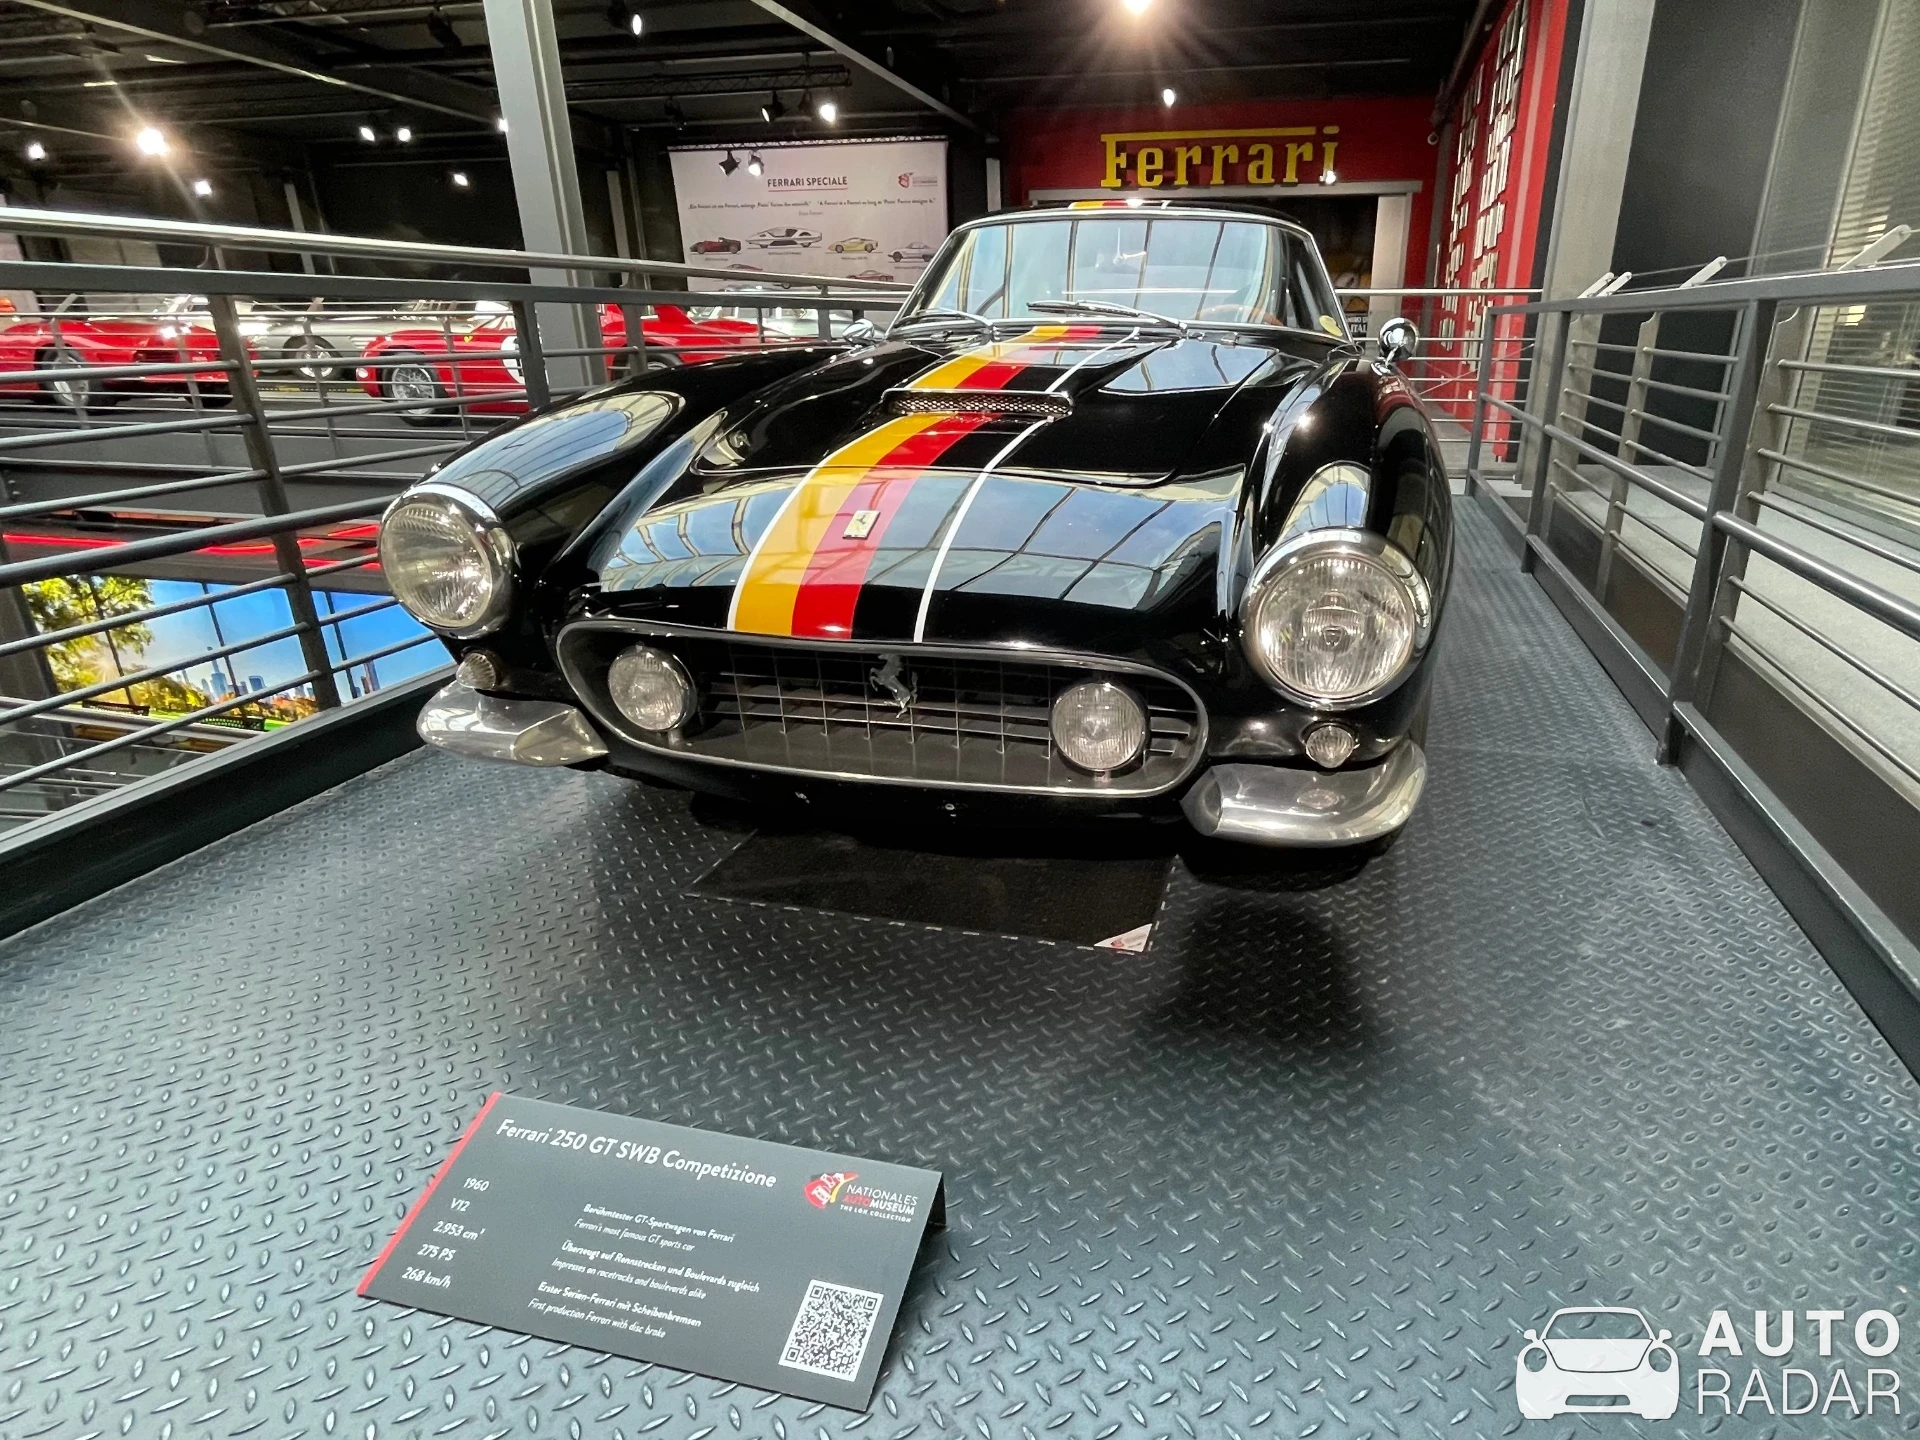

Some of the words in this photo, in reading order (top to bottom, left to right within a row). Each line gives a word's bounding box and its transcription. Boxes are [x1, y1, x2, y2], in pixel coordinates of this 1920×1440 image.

[1100, 125, 1340, 188] Ferrari
[767, 178, 805, 188] FERRARI
[806, 176, 848, 186] SPECIALE
[496, 1119, 553, 1144] Ferrari
[550, 1129, 588, 1150] 250
[589, 1136, 618, 1156] GT
[616, 1141, 661, 1165] SWB
[663, 1150, 777, 1188] Competizione
[463, 1177, 490, 1192] 1960
[846, 1184, 918, 1206] NATIONALES
[450, 1197, 471, 1212] V12
[840, 1204, 852, 1212] THE
[869, 1209, 912, 1223] COLLECTION
[432, 1220, 464, 1237] 2.953
[583, 1203, 634, 1222] Berühmtester
[634, 1213, 692, 1235] GT-Sportwagen
[692, 1228, 707, 1237] von
[707, 1228, 736, 1243] Ferrari
[602, 1226, 621, 1237] most
[618, 1228, 648, 1242] famous
[648, 1234, 662, 1244] GT
[659, 1238, 683, 1249] sports
[416, 1243, 440, 1258] 275
[438, 1247, 457, 1261] PS
[401, 1266, 426, 1282] 268
[423, 1271, 452, 1288] km/h
[551, 1257, 587, 1273] Impresses
[596, 1269, 635, 1283] racetracks
[634, 1277, 652, 1287] and
[649, 1279, 688, 1296] boulevards
[687, 1287, 707, 1300] alike
[600, 1251, 616, 1261] auf
[614, 1252, 667, 1273] Rennstrecken
[667, 1266, 685, 1276] und
[684, 1267, 727, 1286] Boulevards
[727, 1280, 760, 1293] zugleich
[537, 1281, 562, 1295] Erster
[562, 1286, 618, 1308] Serien-Ferrari
[616, 1300, 632, 1311] mit
[631, 1302, 702, 1327] Scheibenbremsen
[528, 1297, 547, 1311] First
[543, 1304, 586, 1319] production
[585, 1310, 614, 1325] Ferrari
[611, 1318, 629, 1330] with
[628, 1321, 644, 1333] disc
[643, 1324, 667, 1339] brake
